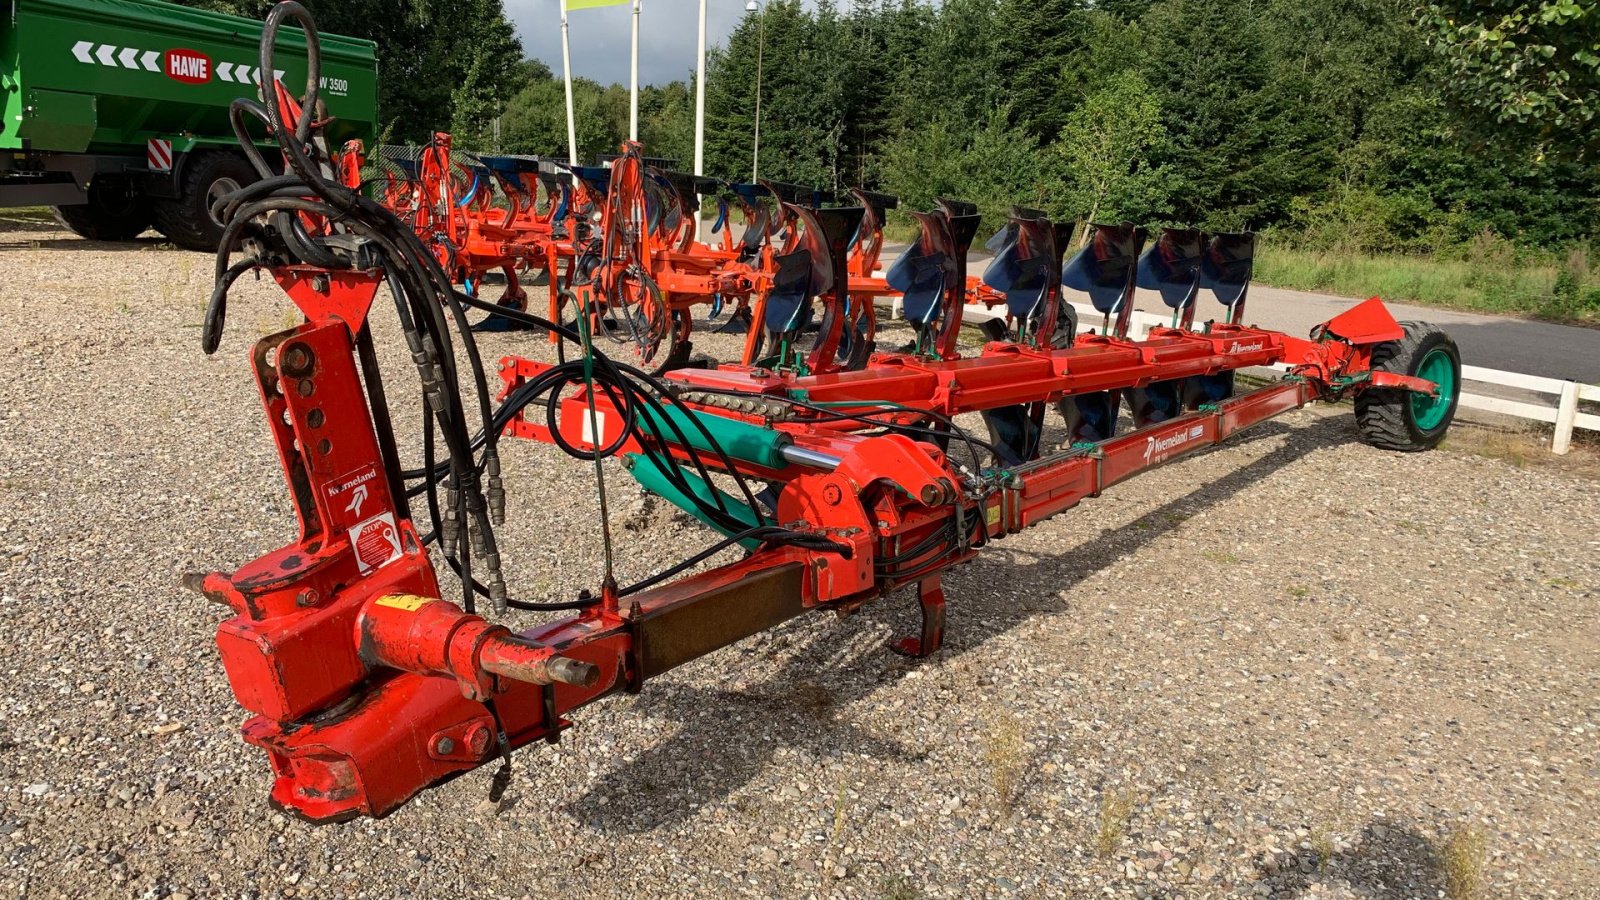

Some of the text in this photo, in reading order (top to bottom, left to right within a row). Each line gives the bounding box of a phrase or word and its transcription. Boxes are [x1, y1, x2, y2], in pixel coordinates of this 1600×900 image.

[170, 54, 207, 79] HAWE
[329, 78, 348, 92] 3500
[1154, 427, 1188, 454] Kverneland
